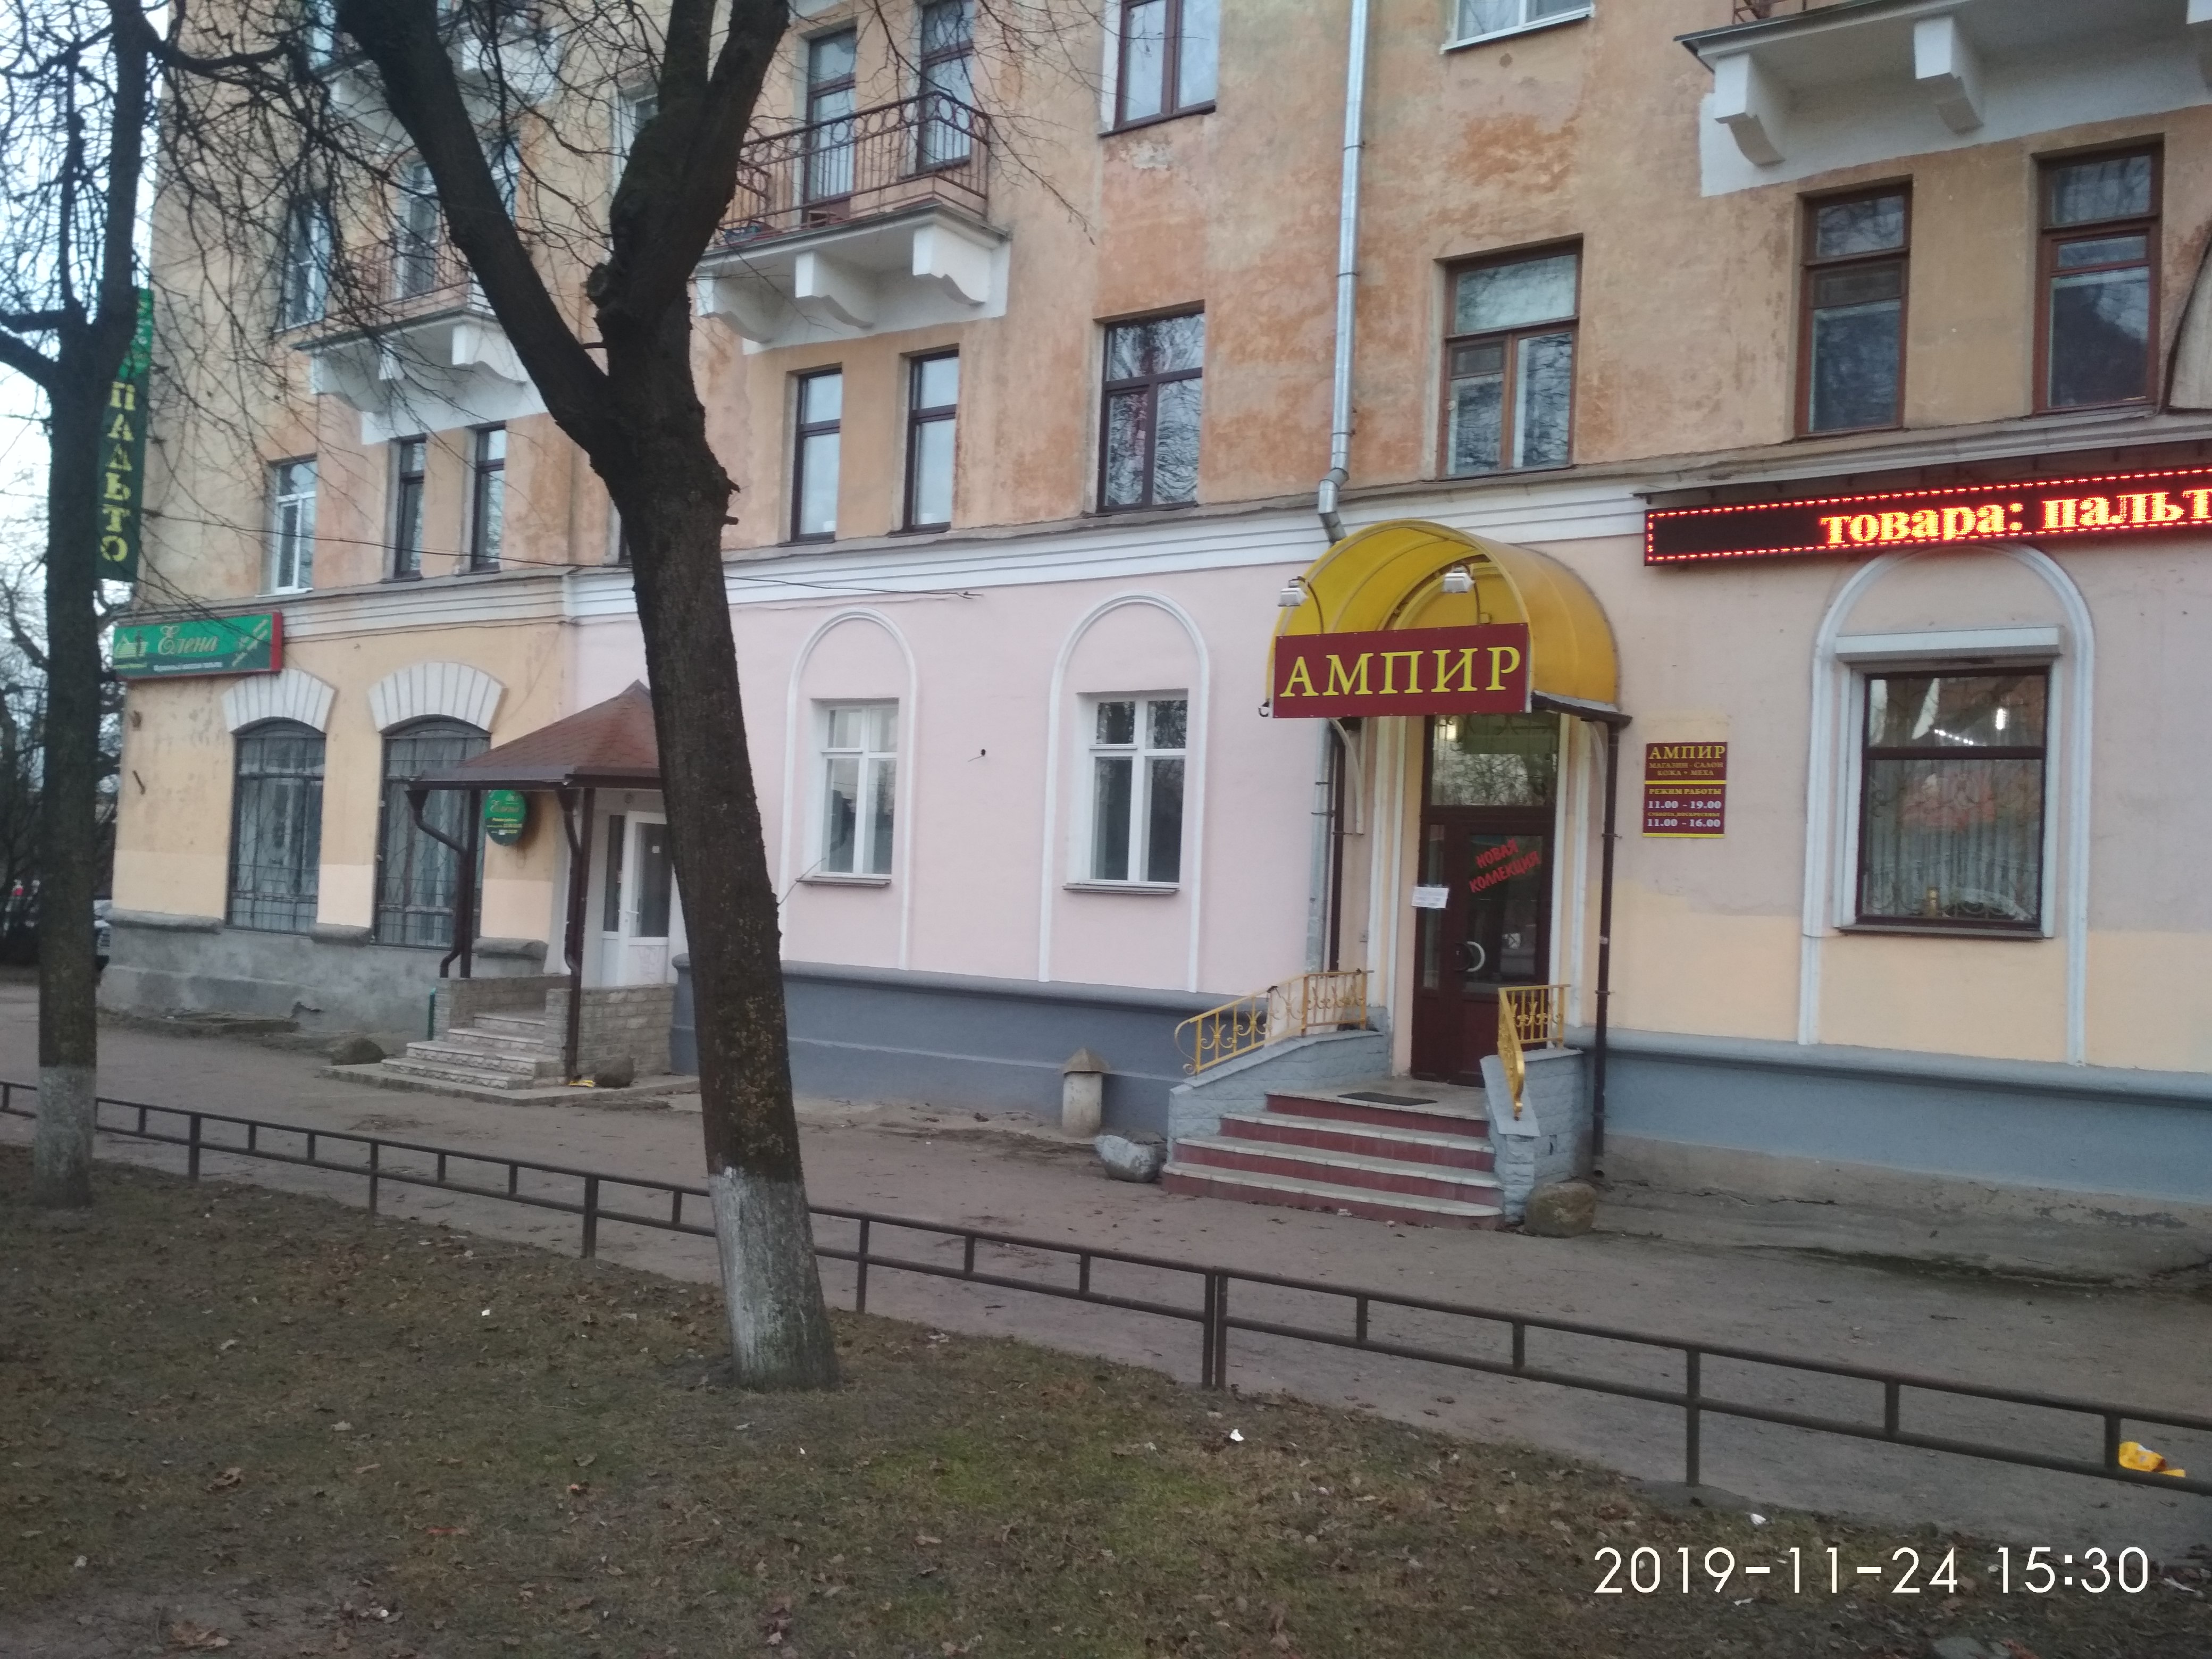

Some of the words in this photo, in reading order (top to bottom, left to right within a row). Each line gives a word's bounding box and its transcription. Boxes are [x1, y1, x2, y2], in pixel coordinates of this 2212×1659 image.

[100, 381, 136, 562] ПАЛЬТО
[1820, 503, 2023, 544] товара:
[2041, 488, 2212, 529] пальт
[1279, 646, 1521, 698] АМПИР
[1648, 745, 1725, 759] АМПИР
[1648, 800, 1679, 809] 11.00
[1469, 851, 1540, 893] КОЛЛЕКЦИЯ
[1476, 837, 1519, 868] НОВАЯ
